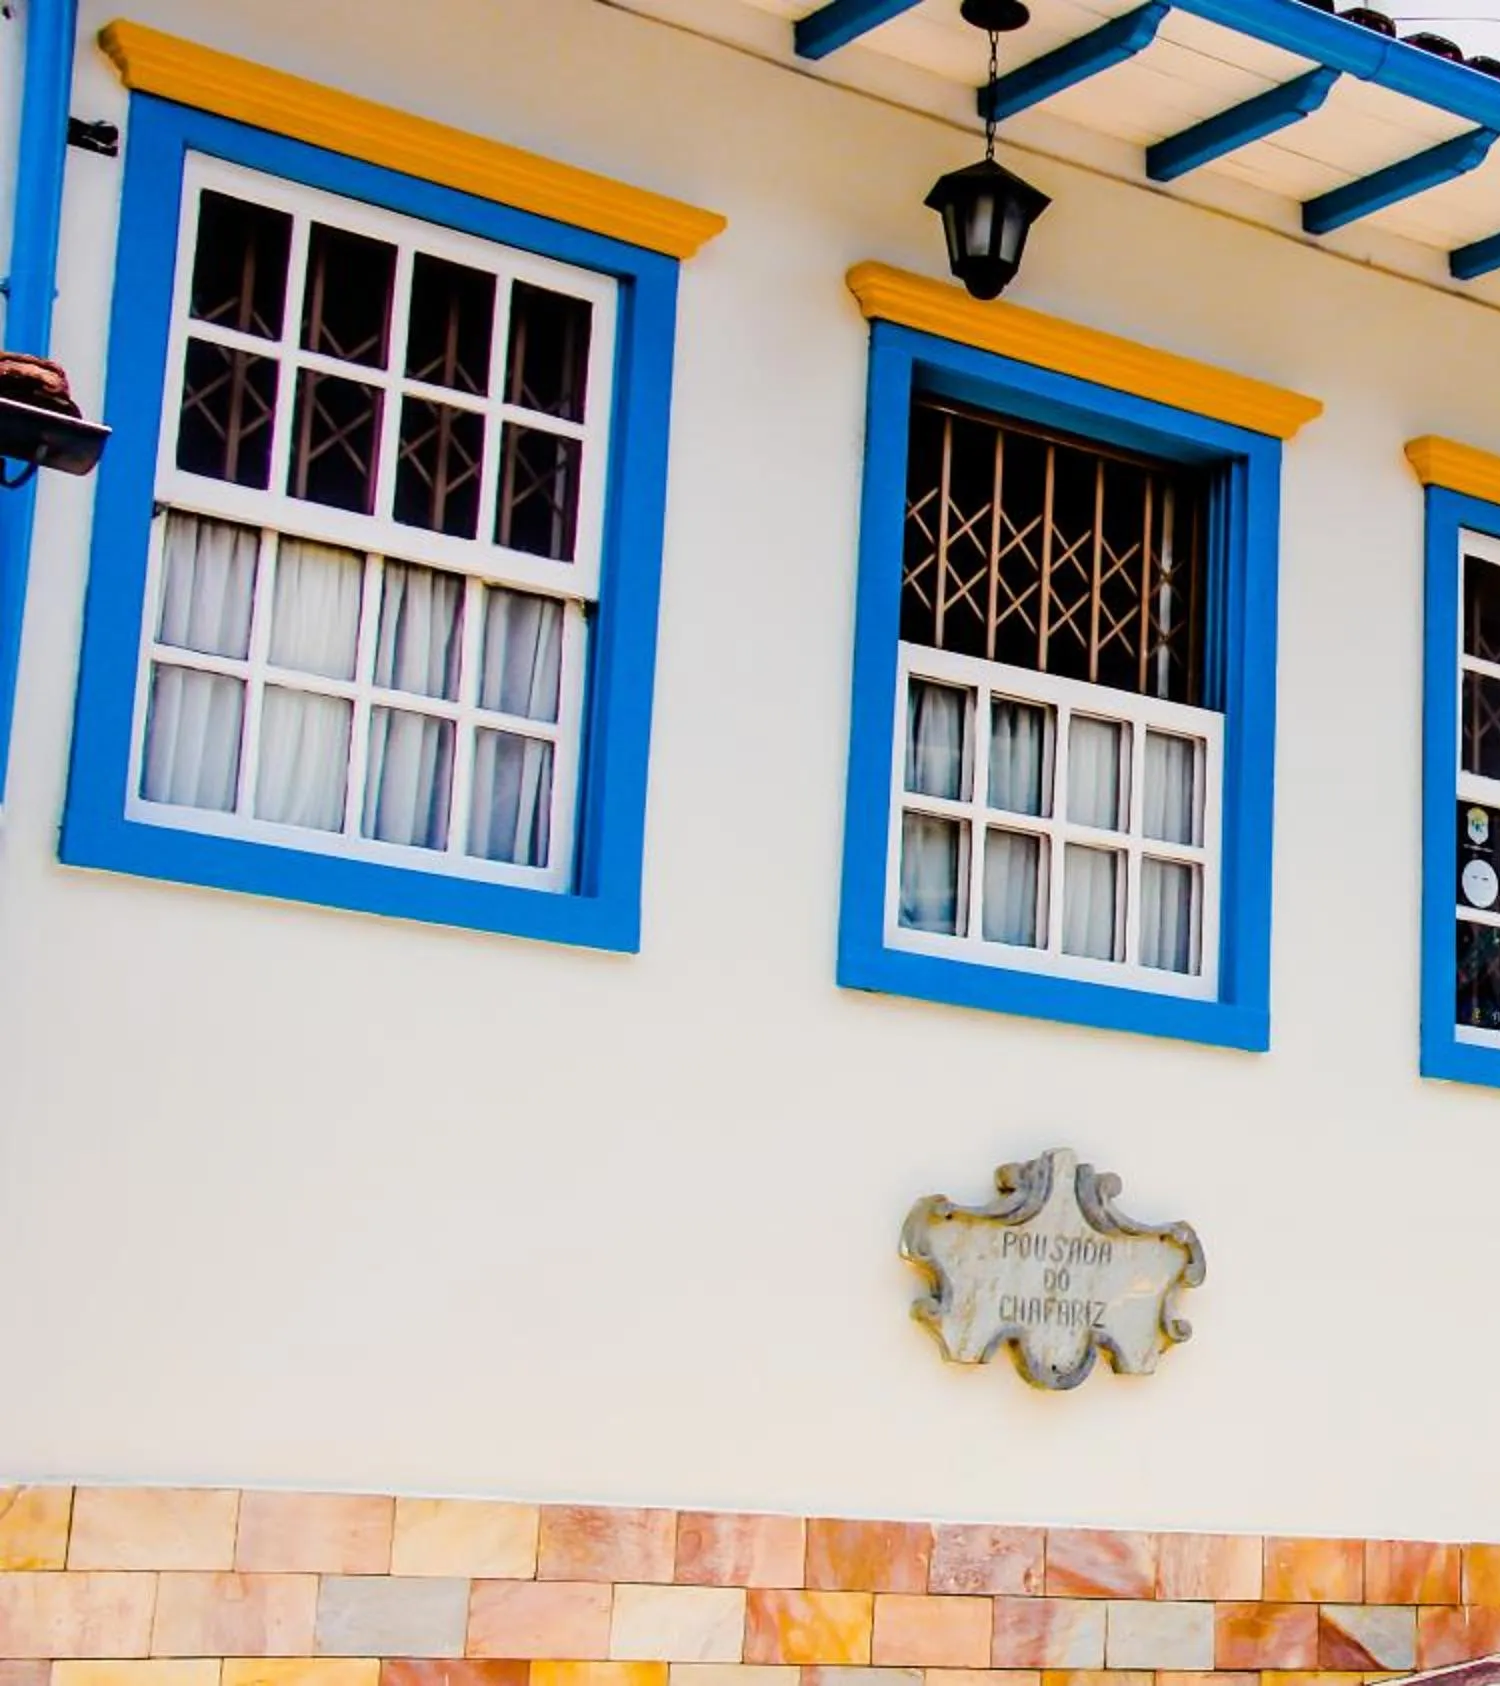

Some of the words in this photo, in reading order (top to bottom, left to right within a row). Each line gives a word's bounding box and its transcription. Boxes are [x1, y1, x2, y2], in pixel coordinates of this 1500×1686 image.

[1002, 1231, 1112, 1265] POUSADA
[1043, 1269, 1070, 1292] DO
[1000, 1296, 1108, 1328] CHAFARIZ
